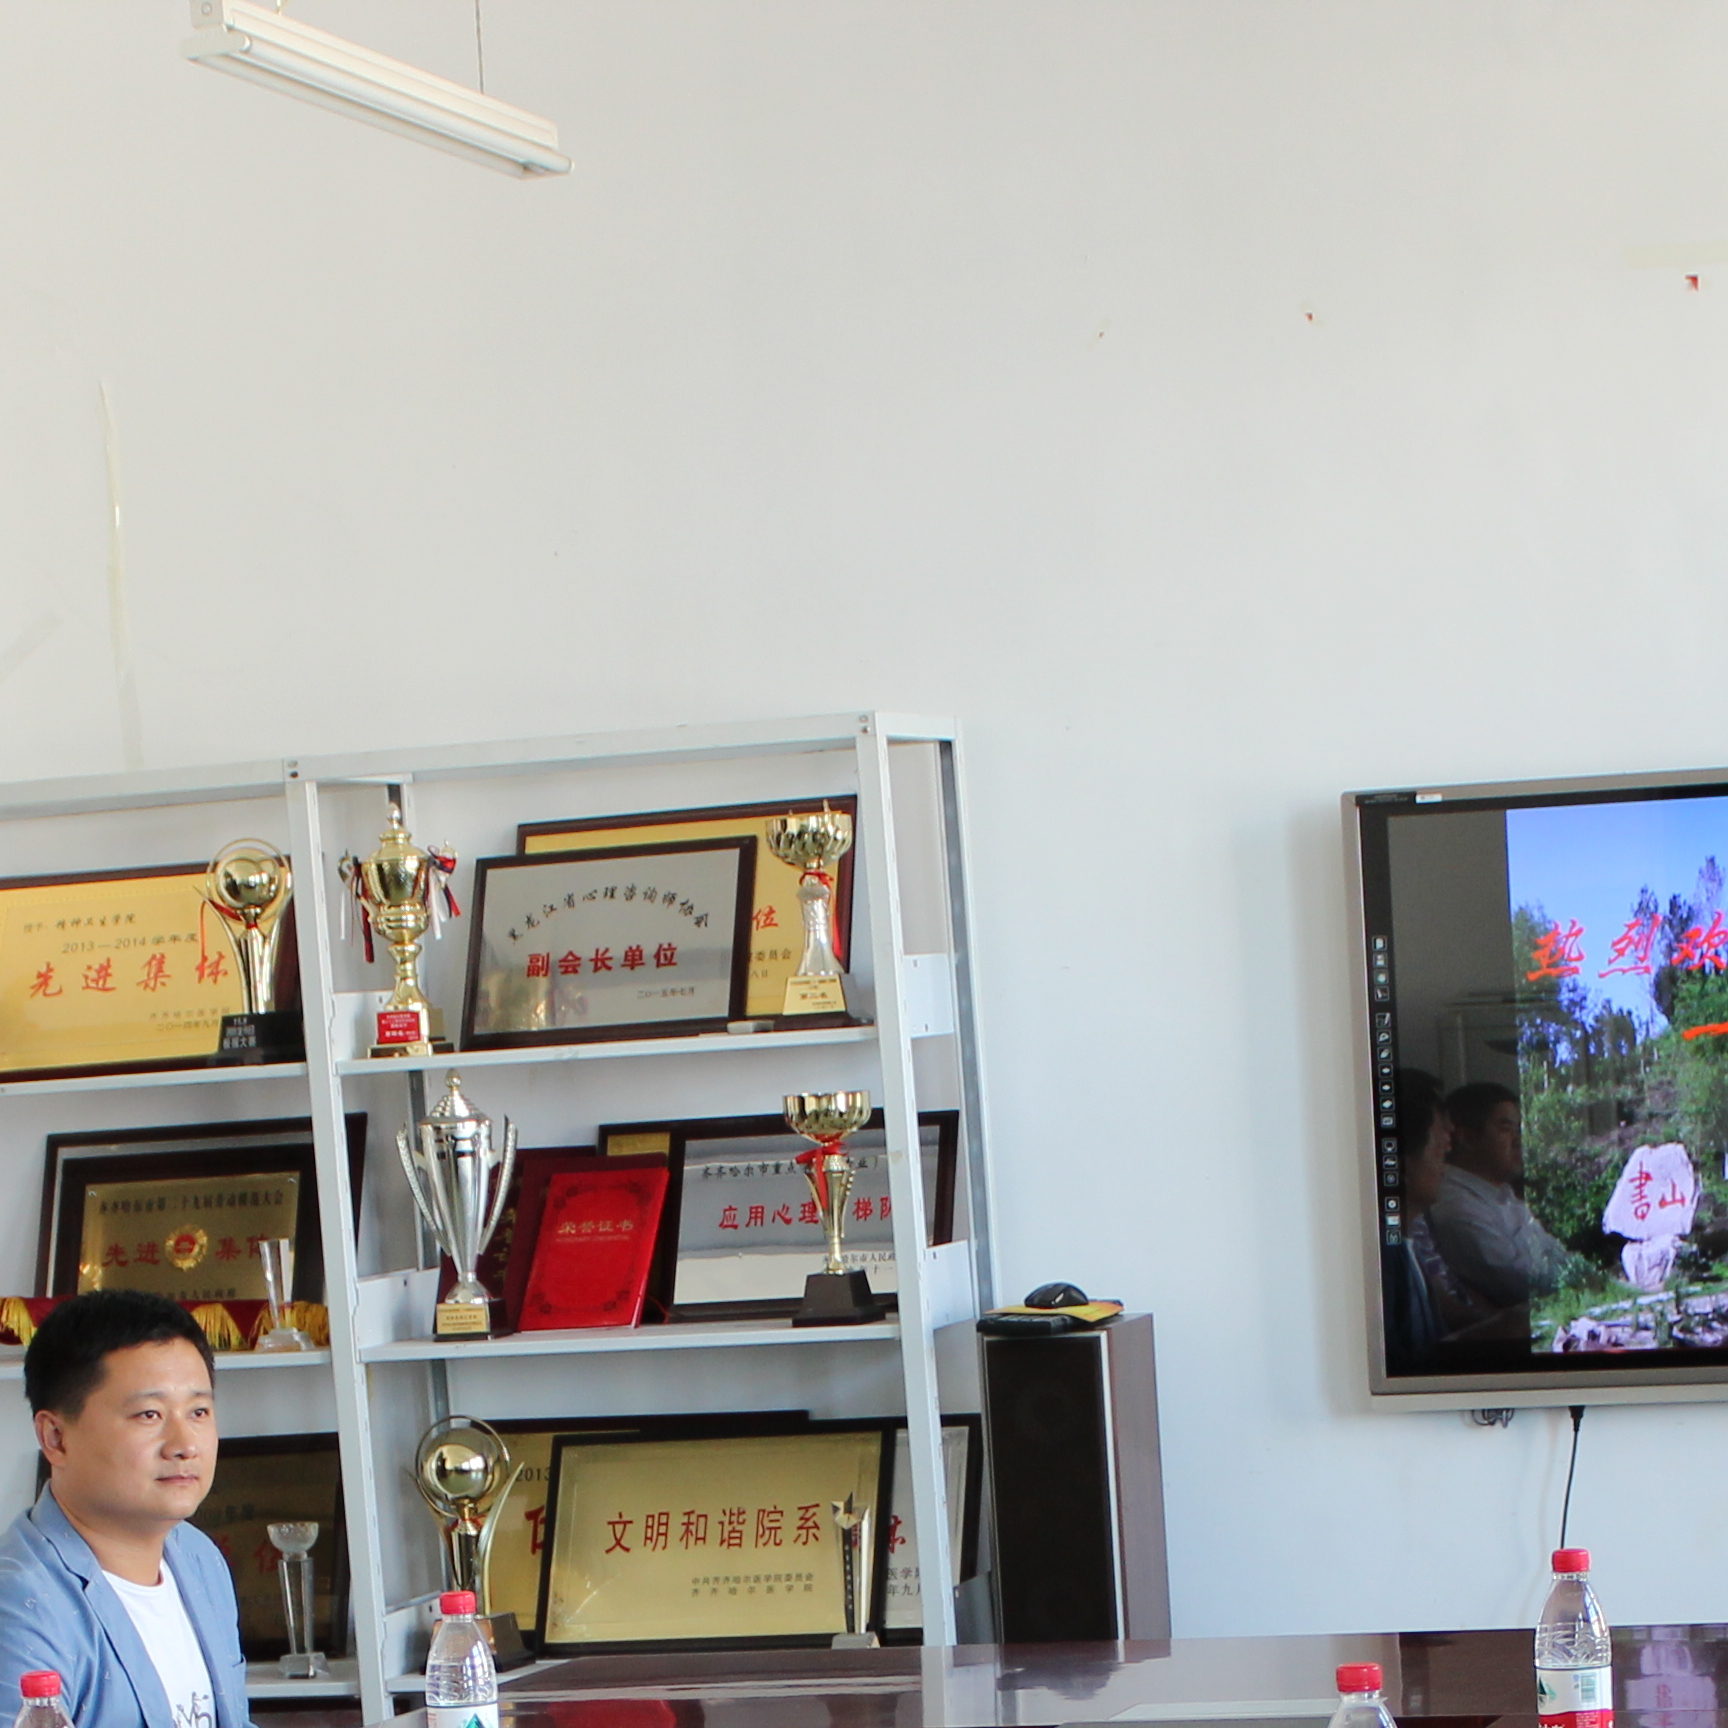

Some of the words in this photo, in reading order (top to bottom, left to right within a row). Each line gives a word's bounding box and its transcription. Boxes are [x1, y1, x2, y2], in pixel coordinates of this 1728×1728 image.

[526, 942, 678, 978] 副会长单位
[101, 1241, 161, 1267] 先进
[604, 1502, 821, 1554] 文明和谐院系
